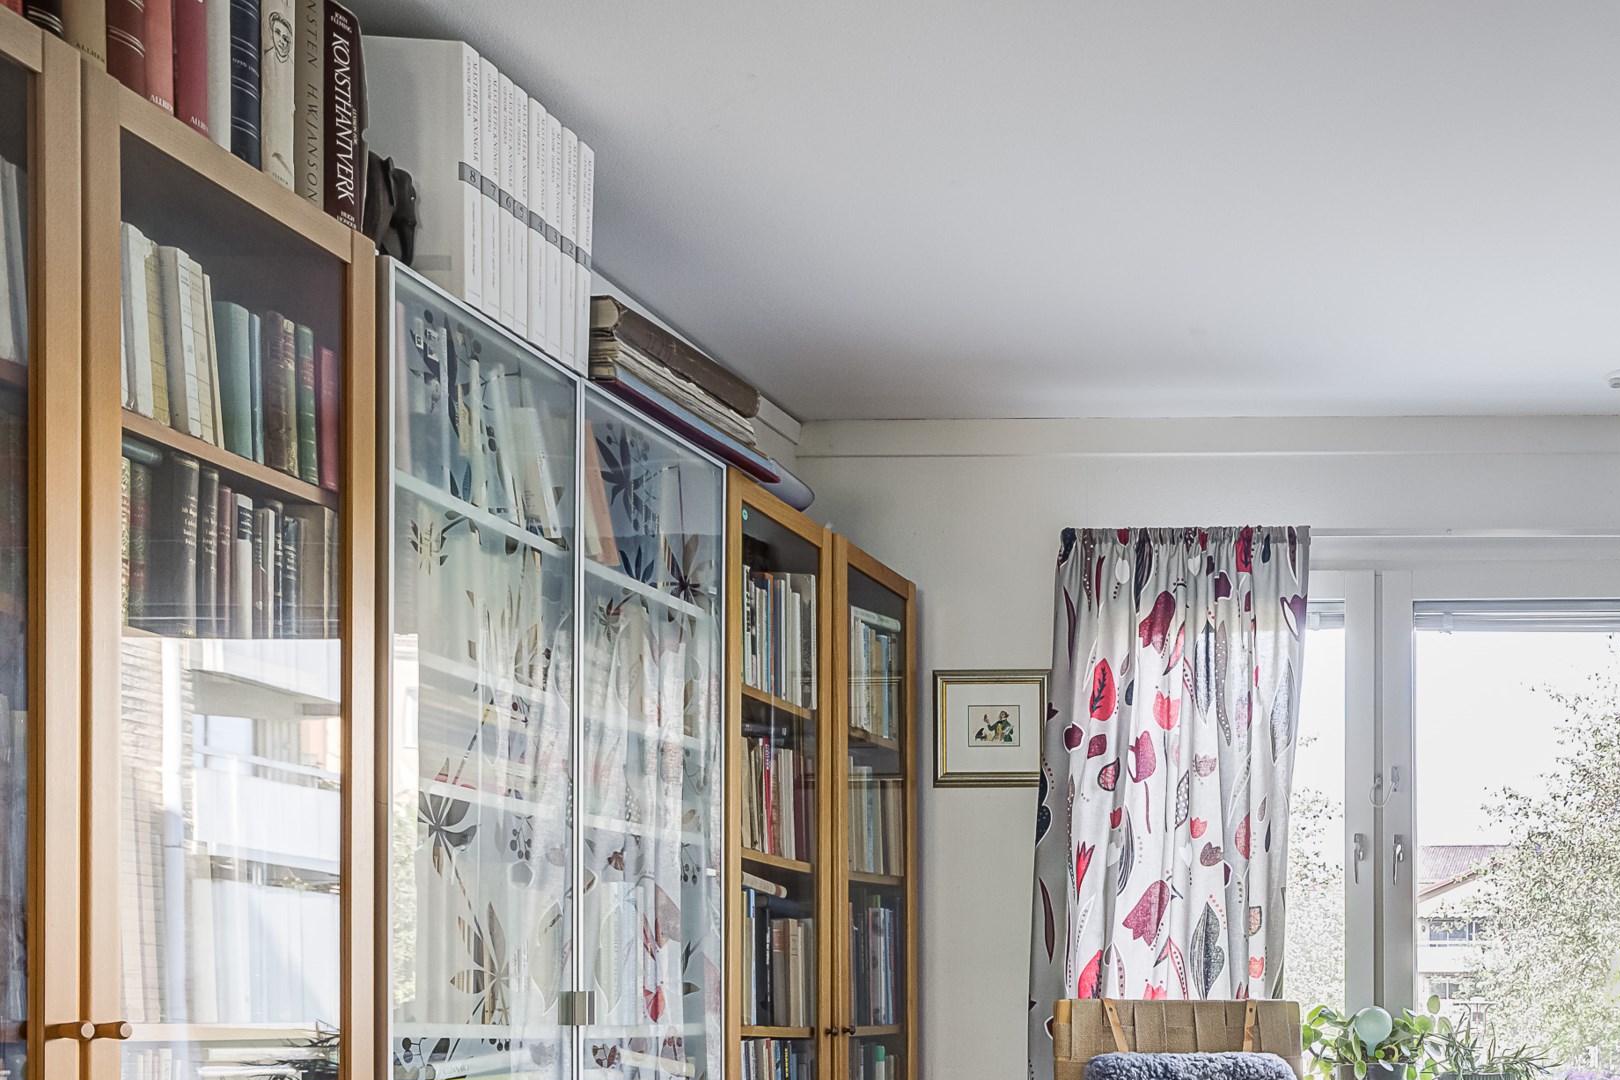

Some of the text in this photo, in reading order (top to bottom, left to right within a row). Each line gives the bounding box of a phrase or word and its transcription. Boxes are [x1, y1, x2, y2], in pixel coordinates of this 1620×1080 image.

[330, 16, 352, 33] FLEMING
[331, 32, 354, 205] KONSTHANTVERK
[469, 170, 477, 183] 8
[505, 196, 512, 209] 6
